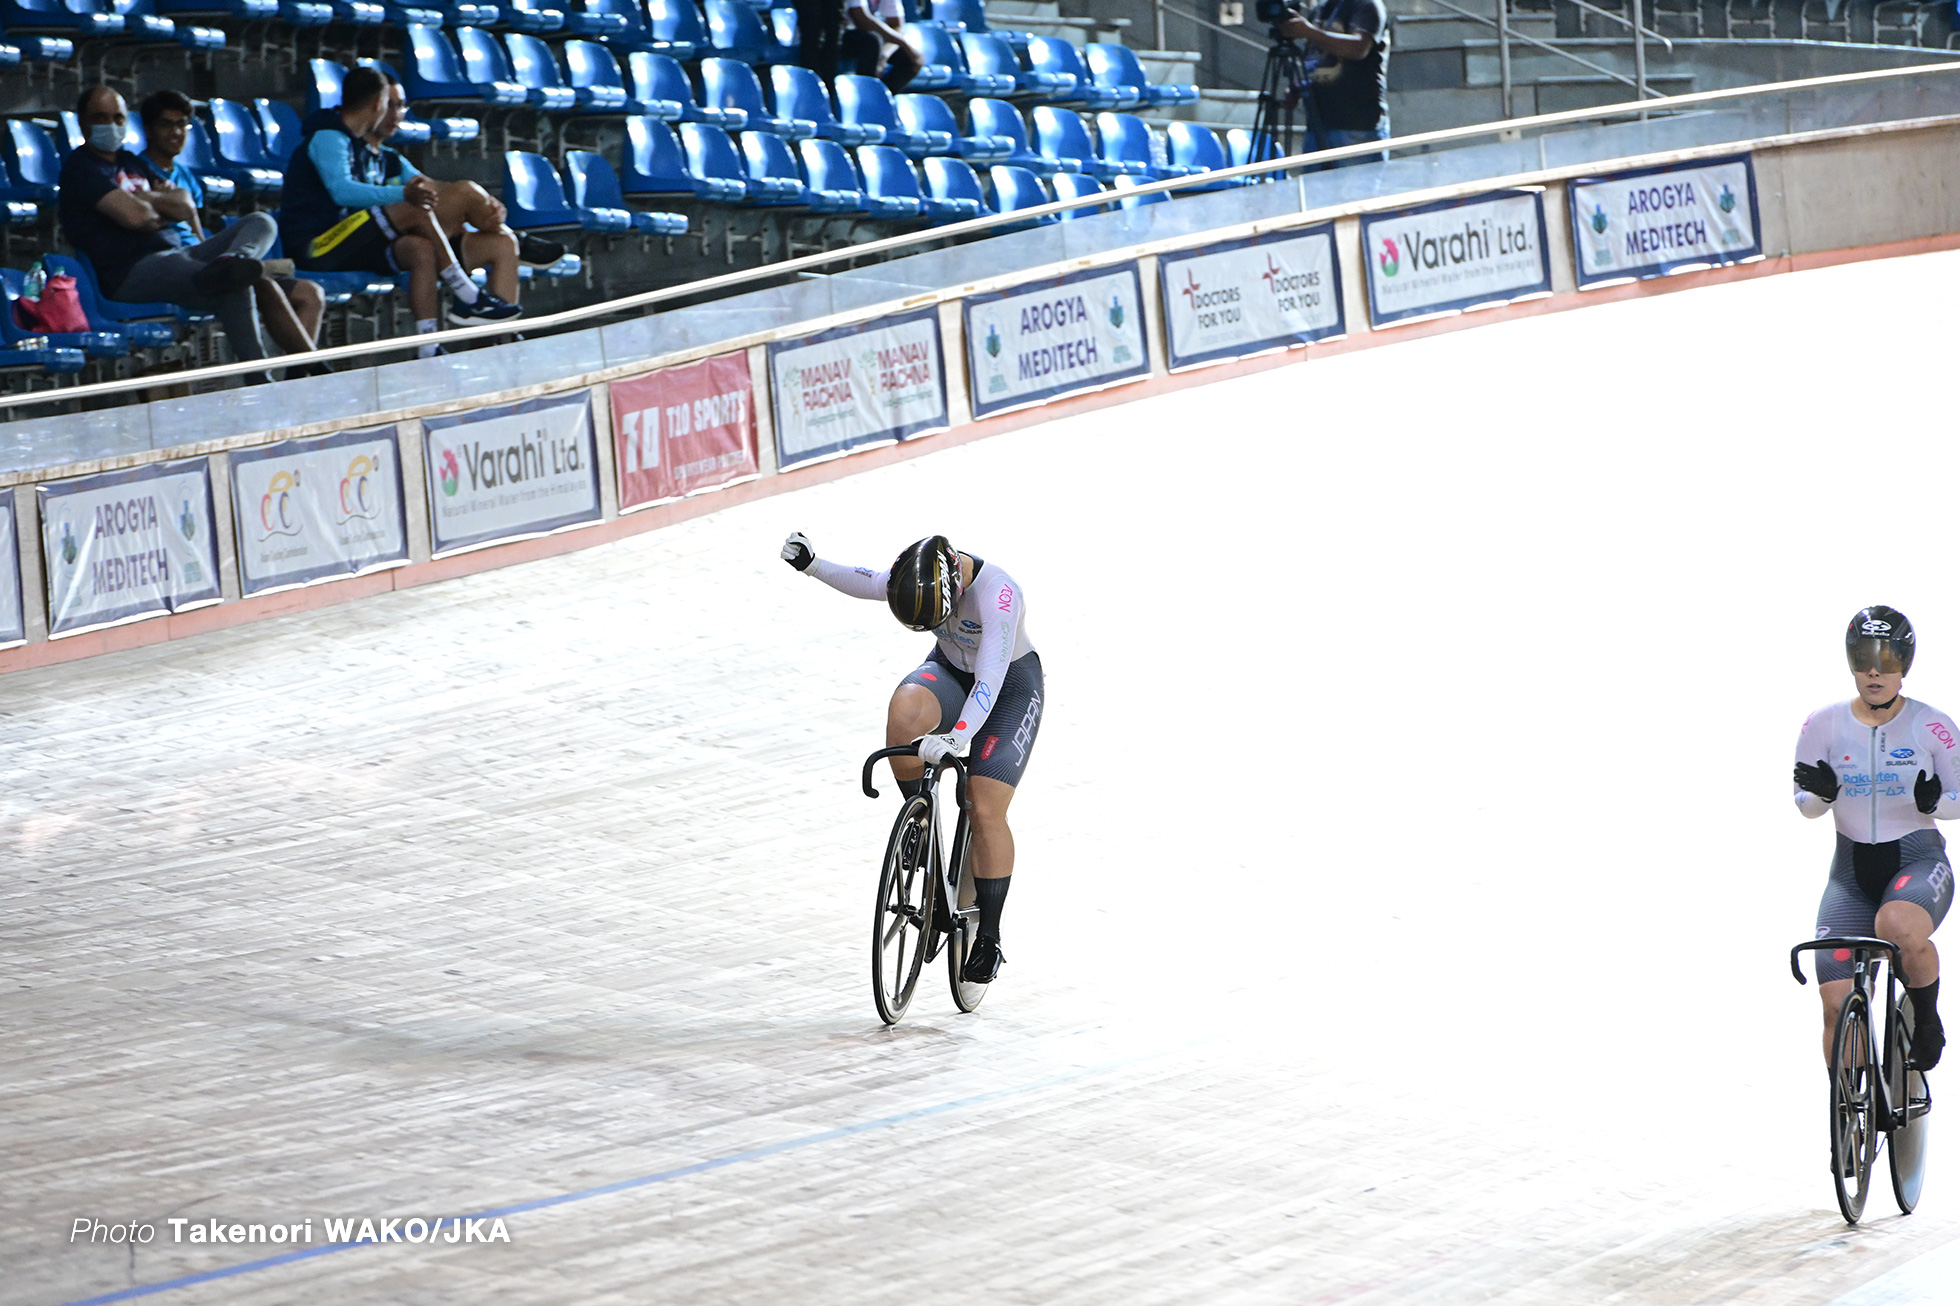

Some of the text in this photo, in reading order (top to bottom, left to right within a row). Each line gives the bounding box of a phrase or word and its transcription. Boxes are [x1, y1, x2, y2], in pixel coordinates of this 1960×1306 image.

[1628, 182, 1696, 215] AROGYA
[1404, 220, 1533, 271] Varahi Ltd.
[1626, 220, 1706, 256] MEDITECH
[1195, 287, 1241, 309] DOCTORS
[1275, 272, 1320, 293] DOCTORS
[1021, 295, 1087, 335] AROGYA
[1198, 308, 1241, 329] FOR YOU
[1278, 292, 1320, 312] FOR YOU
[801, 358, 851, 389] MANAV
[878, 341, 929, 370] MANAV
[1019, 337, 1099, 380] MEDITECH
[694, 390, 746, 432] SPORTS
[463, 430, 585, 491] Varahi Ltd.
[94, 496, 158, 540] AROGYA
[93, 548, 169, 595] MEDITECH
[1011, 690, 1040, 767] JAPAN
[1843, 772, 1899, 784] Rakuten
